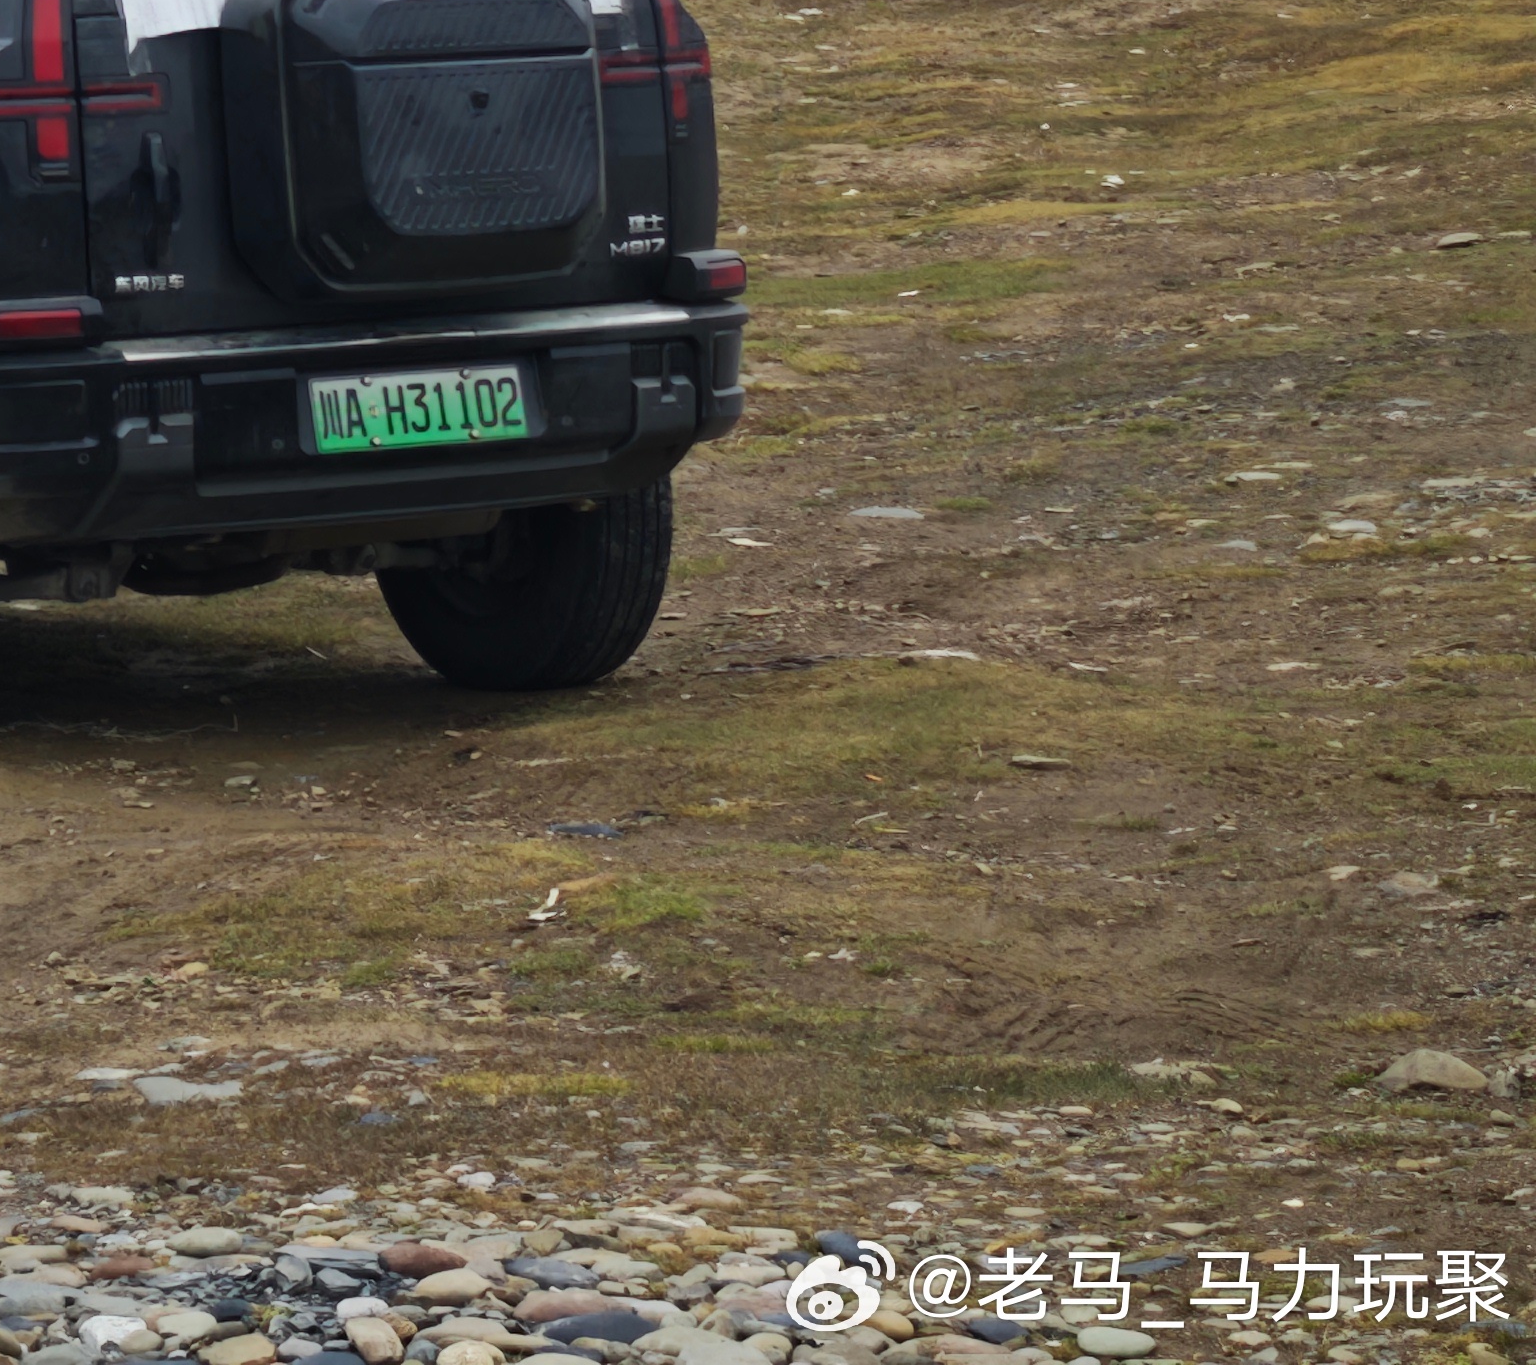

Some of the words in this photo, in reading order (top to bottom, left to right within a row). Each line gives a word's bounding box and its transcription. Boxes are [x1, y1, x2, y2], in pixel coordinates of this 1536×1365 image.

[609, 237, 666, 258] M817
[114, 272, 186, 294] 东风汽车
